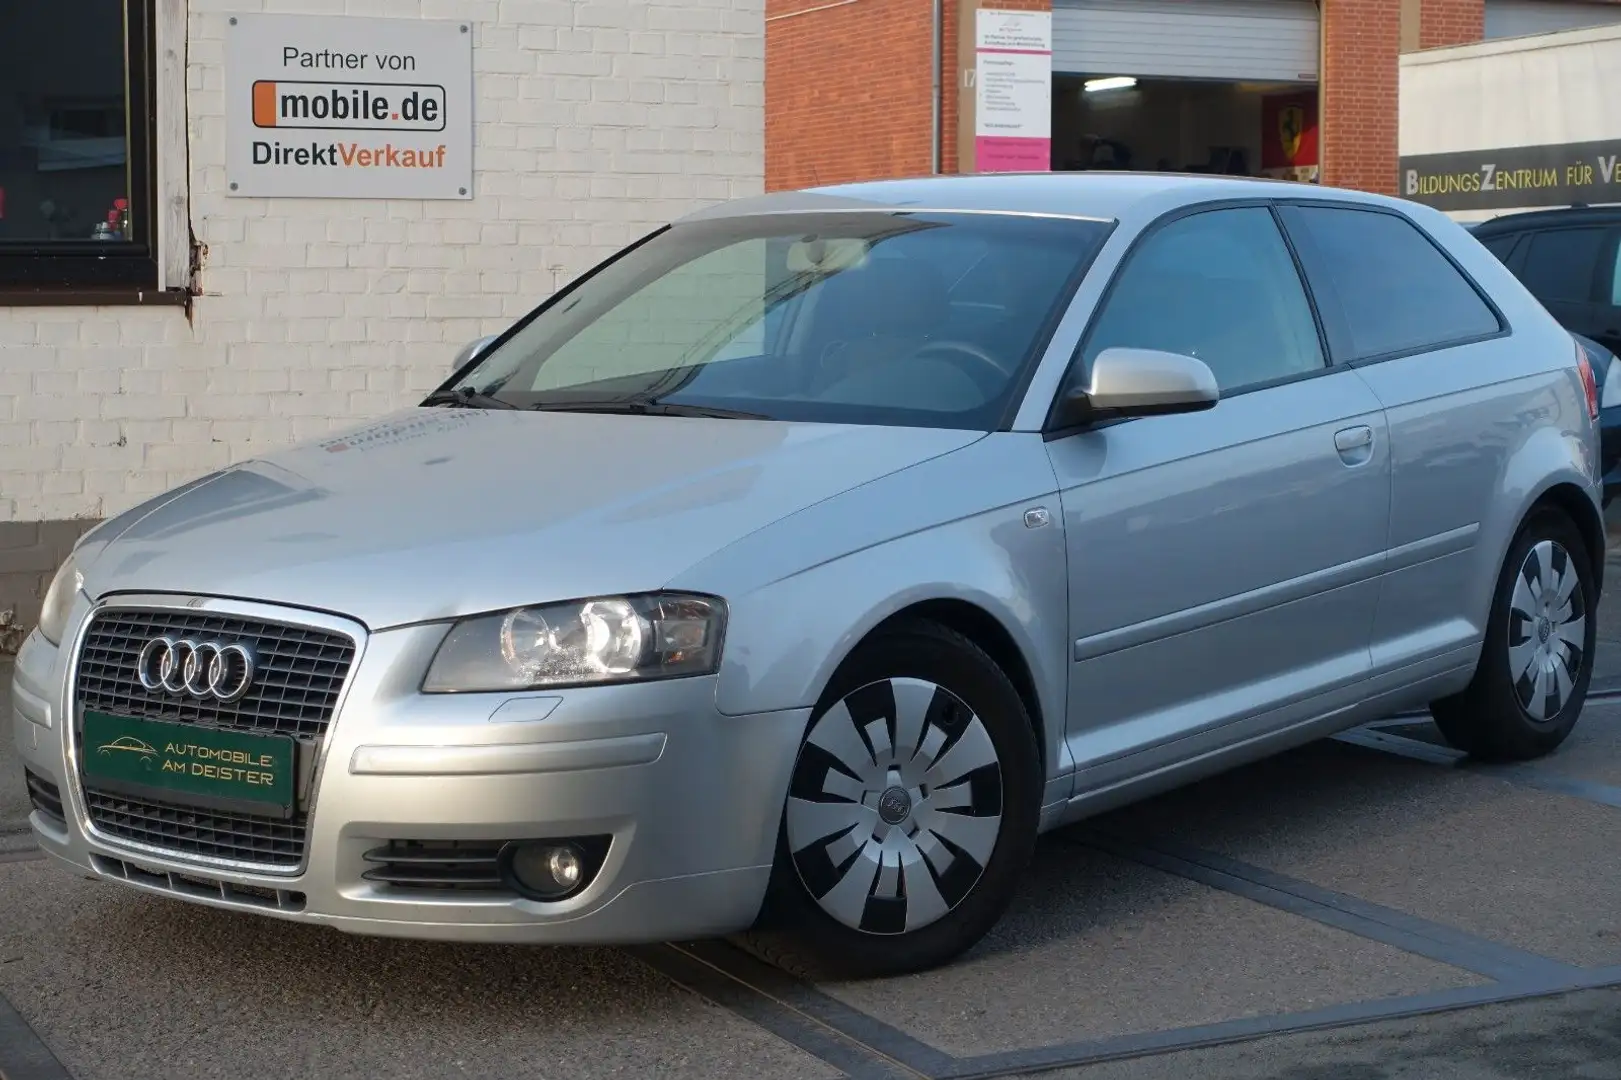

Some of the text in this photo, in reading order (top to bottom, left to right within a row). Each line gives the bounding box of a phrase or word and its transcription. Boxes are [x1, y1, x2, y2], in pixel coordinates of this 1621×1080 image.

[283, 46, 416, 71] Partner von
[281, 89, 438, 121] mobile.de
[252, 141, 447, 168] DirektVerkauf
[1566, 161, 1593, 186] FÜR
[165, 742, 273, 767] AUTOMOBILE
[162, 759, 274, 786] AM DEISTER
